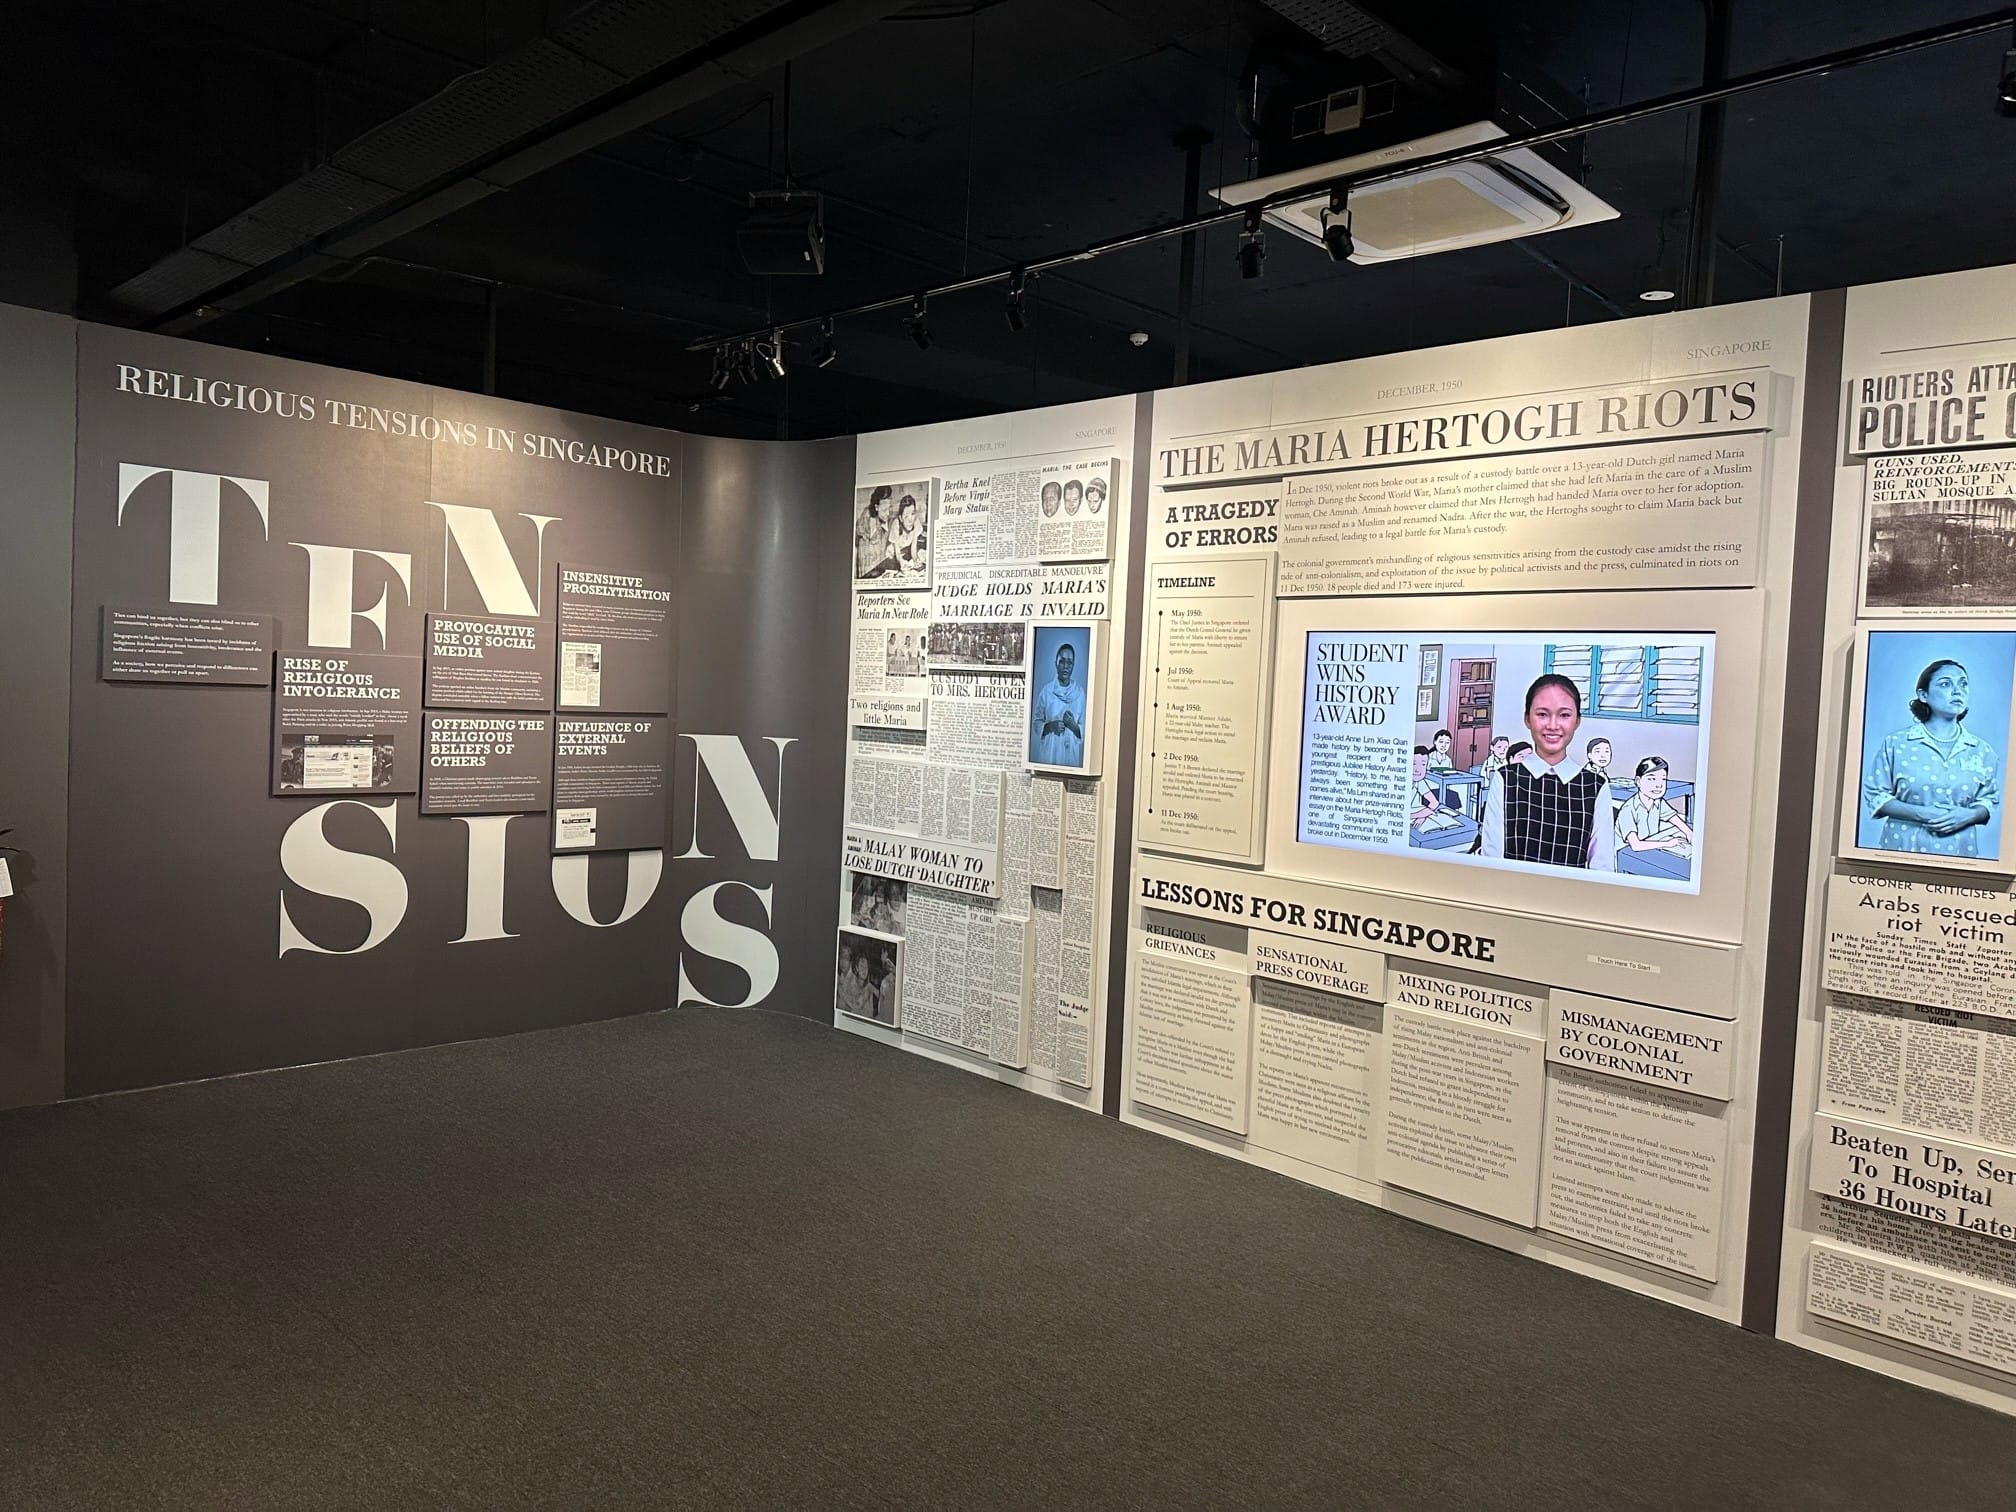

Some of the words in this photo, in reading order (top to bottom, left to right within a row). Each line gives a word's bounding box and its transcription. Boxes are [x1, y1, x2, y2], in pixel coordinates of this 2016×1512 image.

[1687, 339, 1772, 360] SINGAPORE
[1376, 383, 1439, 400] DECEMBER,
[1441, 379, 1463, 391] 1950
[1862, 368, 1954, 404] RIOTERS
[115, 364, 315, 421] RELIGIOUS
[325, 400, 478, 447] TENSIONS
[485, 426, 516, 453] IN
[523, 433, 671, 478] SINGAPORE
[1159, 444, 1225, 478] THE
[1233, 429, 1352, 472] MARIA
[1361, 400, 1584, 458] HERTOGH
[1596, 381, 1756, 434] RIOTS
[1858, 395, 1987, 451] POLICE
[1873, 457, 1915, 469] GUNS
[944, 480, 969, 491] Bertha
[1873, 479, 1896, 491] BIG
[1990, 473, 2006, 484] IN
[944, 492, 967, 503] Before
[1873, 489, 1927, 502] SULTAN
[1937, 485, 1995, 499] MOSQUE
[943, 505, 962, 516] Mary
[1165, 506, 1179, 523] A
[1182, 498, 1280, 523] TRAGEDY
[1165, 530, 1193, 548] OF
[1196, 525, 1278, 547] ERRORS
[1283, 533, 1310, 544] Aminah
[1311, 531, 1340, 542] refused,
[1341, 530, 1367, 542] leading
[1369, 531, 1377, 539] to
[1385, 528, 1403, 540] legal
[1404, 527, 1427, 537] battle
[1429, 526, 1441, 536] for
[1443, 524, 1472, 535] Maria's
[1473, 523, 1507, 534] custody.
[563, 570, 643, 588] INSENSITIVE
[989, 568, 1047, 579] DISCREDITABLE
[1157, 577, 1216, 588] TIMELINE
[563, 582, 671, 602] PROSELYTISATION
[934, 583, 979, 598] JUDGE
[985, 582, 1033, 596] HOLDS
[1041, 579, 1106, 595] MARIA'S
[1280, 584, 1288, 592] 11
[1290, 583, 1304, 592] Dec
[1306, 583, 1324, 592] 1950.
[1327, 583, 1336, 592] 18
[1337, 583, 1362, 593] people
[1363, 581, 1380, 590] died
[1382, 581, 1396, 590] and
[1398, 581, 1412, 590] 173
[1434, 579, 1464, 590] injured.
[857, 595, 895, 607] Reporters
[897, 595, 911, 605] See
[939, 603, 1014, 617] MARRIAGE
[1020, 603, 1033, 617] IS
[1040, 602, 1105, 617] INVALID
[857, 608, 882, 619] Maria
[882, 608, 891, 619] In
[892, 608, 909, 619] New
[910, 608, 929, 619] Role
[434, 619, 535, 638] PROVOCATIVE
[434, 632, 460, 645] USE
[463, 634, 483, 646] OF
[485, 636, 536, 650] SOCIAL
[433, 645, 484, 658] MEDIA
[1317, 643, 1409, 663] STUDENT
[283, 657, 321, 671] RISE
[326, 659, 348, 672] OF
[1317, 663, 1365, 683] WINS
[283, 671, 373, 686] RELIGIOUS
[931, 671, 980, 685] CUSTODY
[989, 673, 1026, 687] GIVEN
[282, 685, 401, 700] INTOLERANCE
[931, 683, 944, 695] TO
[947, 685, 970, 697] MRS.
[974, 686, 1025, 700] HERTOGH
[1315, 684, 1400, 705] HISTORY
[850, 699, 868, 709] Two
[870, 700, 904, 712] religions
[906, 702, 921, 713] and
[1313, 705, 1386, 726] AWARD
[431, 718, 516, 731] OFFENDING
[518, 719, 545, 731] THE
[559, 722, 632, 733] INFLUENCE
[634, 722, 652, 733] OF
[863, 713, 881, 724] little
[884, 715, 907, 726] Maria
[431, 731, 513, 743] RELIGIOUS
[558, 733, 626, 744] EXTERNAL
[1345, 735, 1362, 743] Anne
[1363, 736, 1375, 744] Lim
[1376, 737, 1391, 745] Xiao
[430, 743, 491, 755] BELIEFS
[494, 743, 515, 755] OF
[558, 745, 608, 756] EVENTS
[430, 756, 487, 767] OTHERS
[864, 839, 907, 859] MALAY
[910, 846, 959, 869] WOMAN
[964, 856, 984, 874] TO
[844, 854, 873, 871] LOSE
[874, 859, 915, 879] DUTCH
[1849, 875, 1913, 891] CORONER
[1926, 883, 1997, 900] CRITICISES
[1858, 892, 1921, 914] Arabs
[1931, 905, 2016, 926] rescued
[1141, 877, 1244, 916] LESSONS
[1250, 897, 1307, 927] FOR
[1313, 908, 1496, 963] SINGAPORE
[1887, 914, 1923, 932] riot
[1940, 921, 2004, 944] victim
[1146, 923, 1207, 944] RELIGIOUS
[1145, 937, 1216, 961] GRIEVANCES
[1256, 945, 1348, 974] SENSATIONAL
[1597, 956, 1614, 965] Touch
[1256, 960, 1293, 978] PRESS
[1296, 969, 1369, 995] COVERAGE
[1398, 974, 1456, 997] MIXING
[1460, 986, 1533, 1013] POLITICS
[1397, 991, 1430, 1007] AND
[1434, 999, 1512, 1026] RELIGION
[1561, 1009, 1723, 1053] MISMANAGEMENT
[1560, 1027, 1583, 1045] BY
[1586, 1032, 1684, 1064] COLONIAL
[1559, 1045, 1693, 1086] GOVERNMENT
[1829, 1125, 1909, 1161] Beaten
[1922, 1145, 1963, 1176] Up,
[1848, 1155, 1878, 1179] To
[1892, 1164, 1992, 1208] Hospital
[1839, 1178, 1865, 1201] 36
[1875, 1186, 1947, 1222] Hours
[1956, 1206, 2016, 1240] Late
